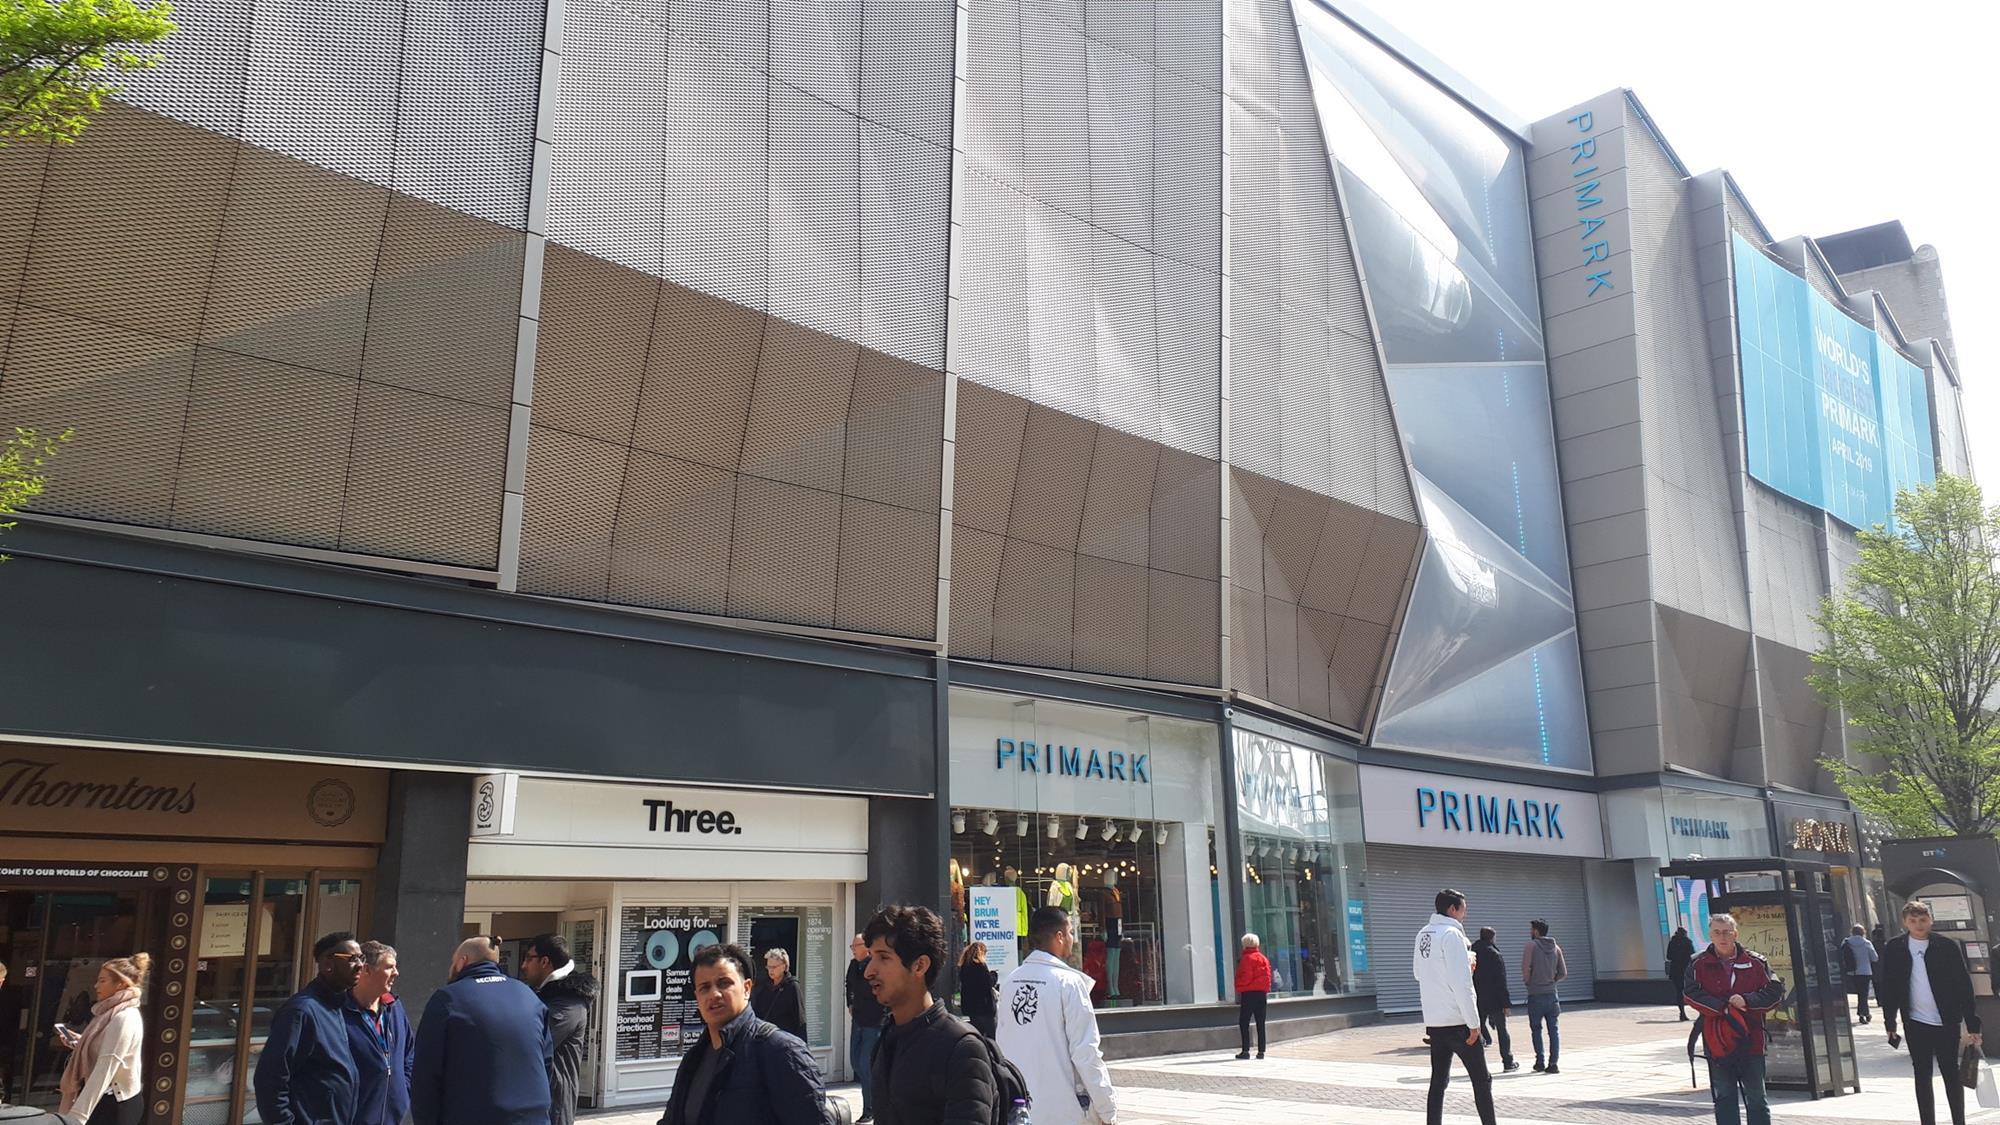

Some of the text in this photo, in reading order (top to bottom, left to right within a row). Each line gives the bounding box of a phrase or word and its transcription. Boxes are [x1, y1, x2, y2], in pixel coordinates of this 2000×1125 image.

[1567, 111, 1615, 298] PRIMARK
[1815, 327, 1870, 385] WORLD'S
[1821, 391, 1879, 448] PRIMARK
[1831, 437, 1854, 464] APRIL
[996, 738, 1150, 784] PRIMARK
[0, 758, 197, 814] Thorntons
[642, 798, 742, 834] Three.
[1416, 787, 1566, 840] PRIMARK
[1670, 816, 1731, 840] PRIMARK
[22, 868, 34, 876] TO
[35, 868, 55, 876] OUR
[56, 868, 86, 877] WORLD
[87, 869, 99, 877] OF
[100, 869, 149, 878] CHOCOLATE
[974, 896, 991, 905] HEY
[974, 908, 999, 917] BRUM
[644, 916, 690, 931] Looking
[693, 915, 717, 929] for...
[974, 920, 1000, 929] WE'RE
[974, 931, 1014, 940] OPENING!
[666, 969, 690, 977] Samsu
[666, 977, 687, 985] Galaxy
[665, 985, 683, 993] deals
[617, 1014, 655, 1024] Bonehead
[616, 1024, 653, 1033] directions
